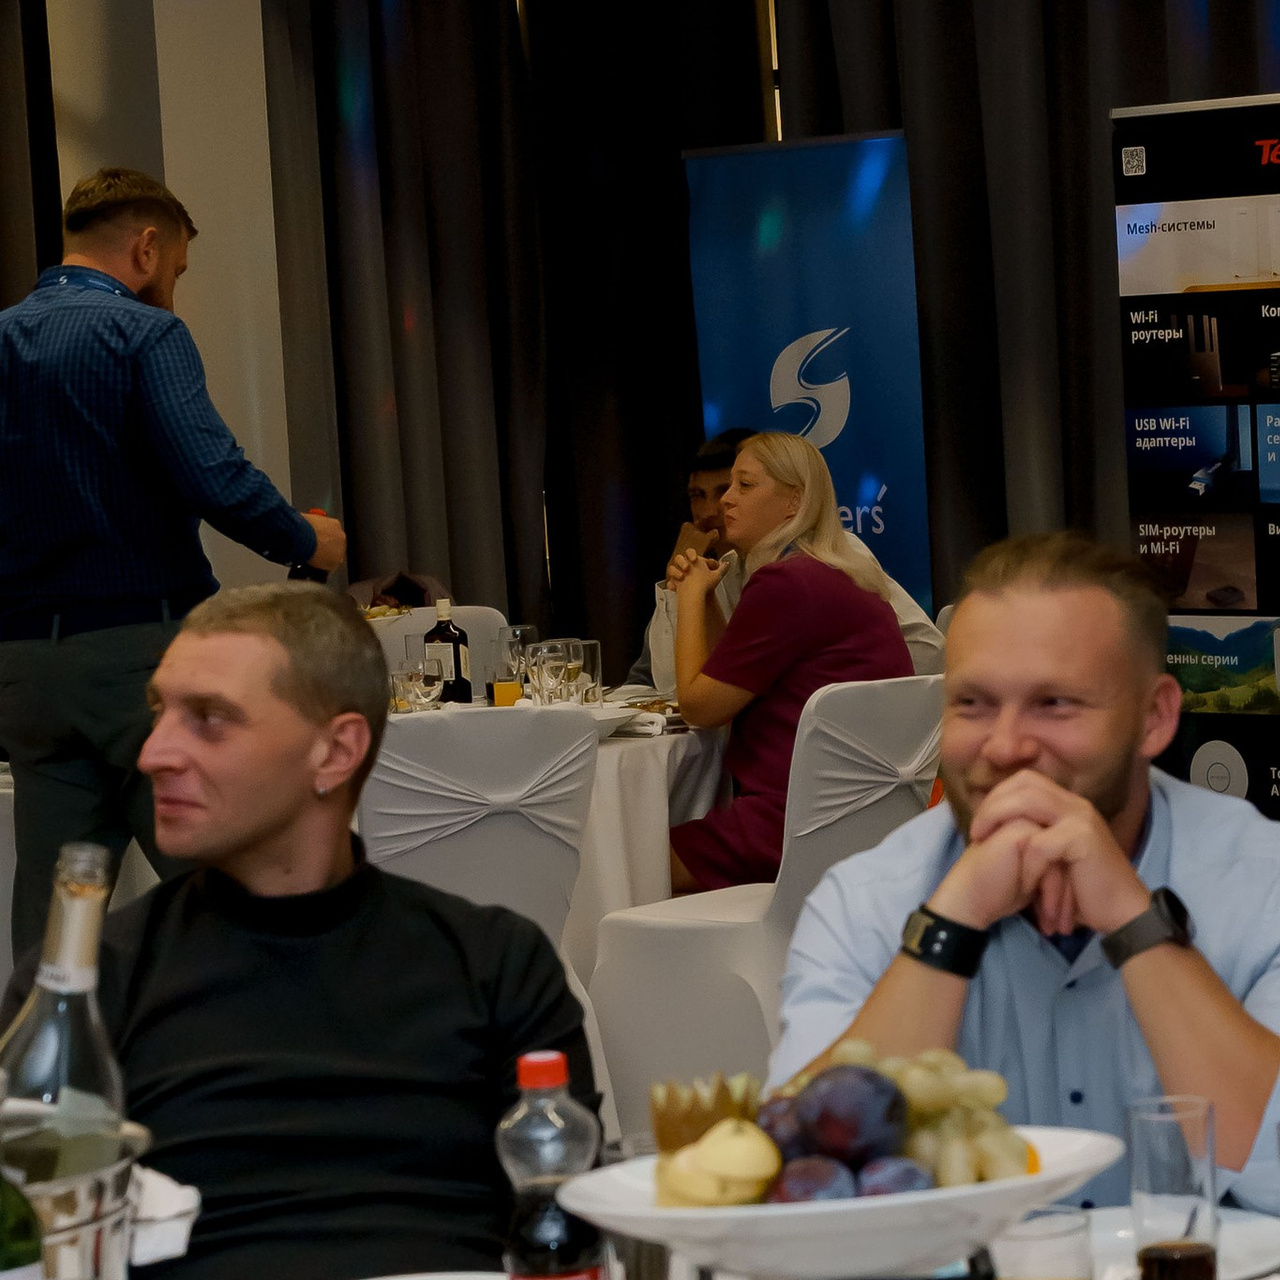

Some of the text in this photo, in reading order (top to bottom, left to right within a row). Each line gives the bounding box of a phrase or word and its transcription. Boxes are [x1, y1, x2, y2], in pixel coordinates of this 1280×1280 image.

[1126, 218, 1217, 235] Mesh-системы
[1130, 310, 1158, 324] Wi-Fi
[1131, 328, 1183, 344] роутеры
[1135, 416, 1190, 431] USB Wi-Fi
[1135, 435, 1196, 450] адаптеры
[1267, 451, 1276, 462] и
[1138, 524, 1216, 539] SIM-роутеры
[1140, 541, 1180, 555] и Mi-Fi
[1166, 654, 1239, 669] енны серии
